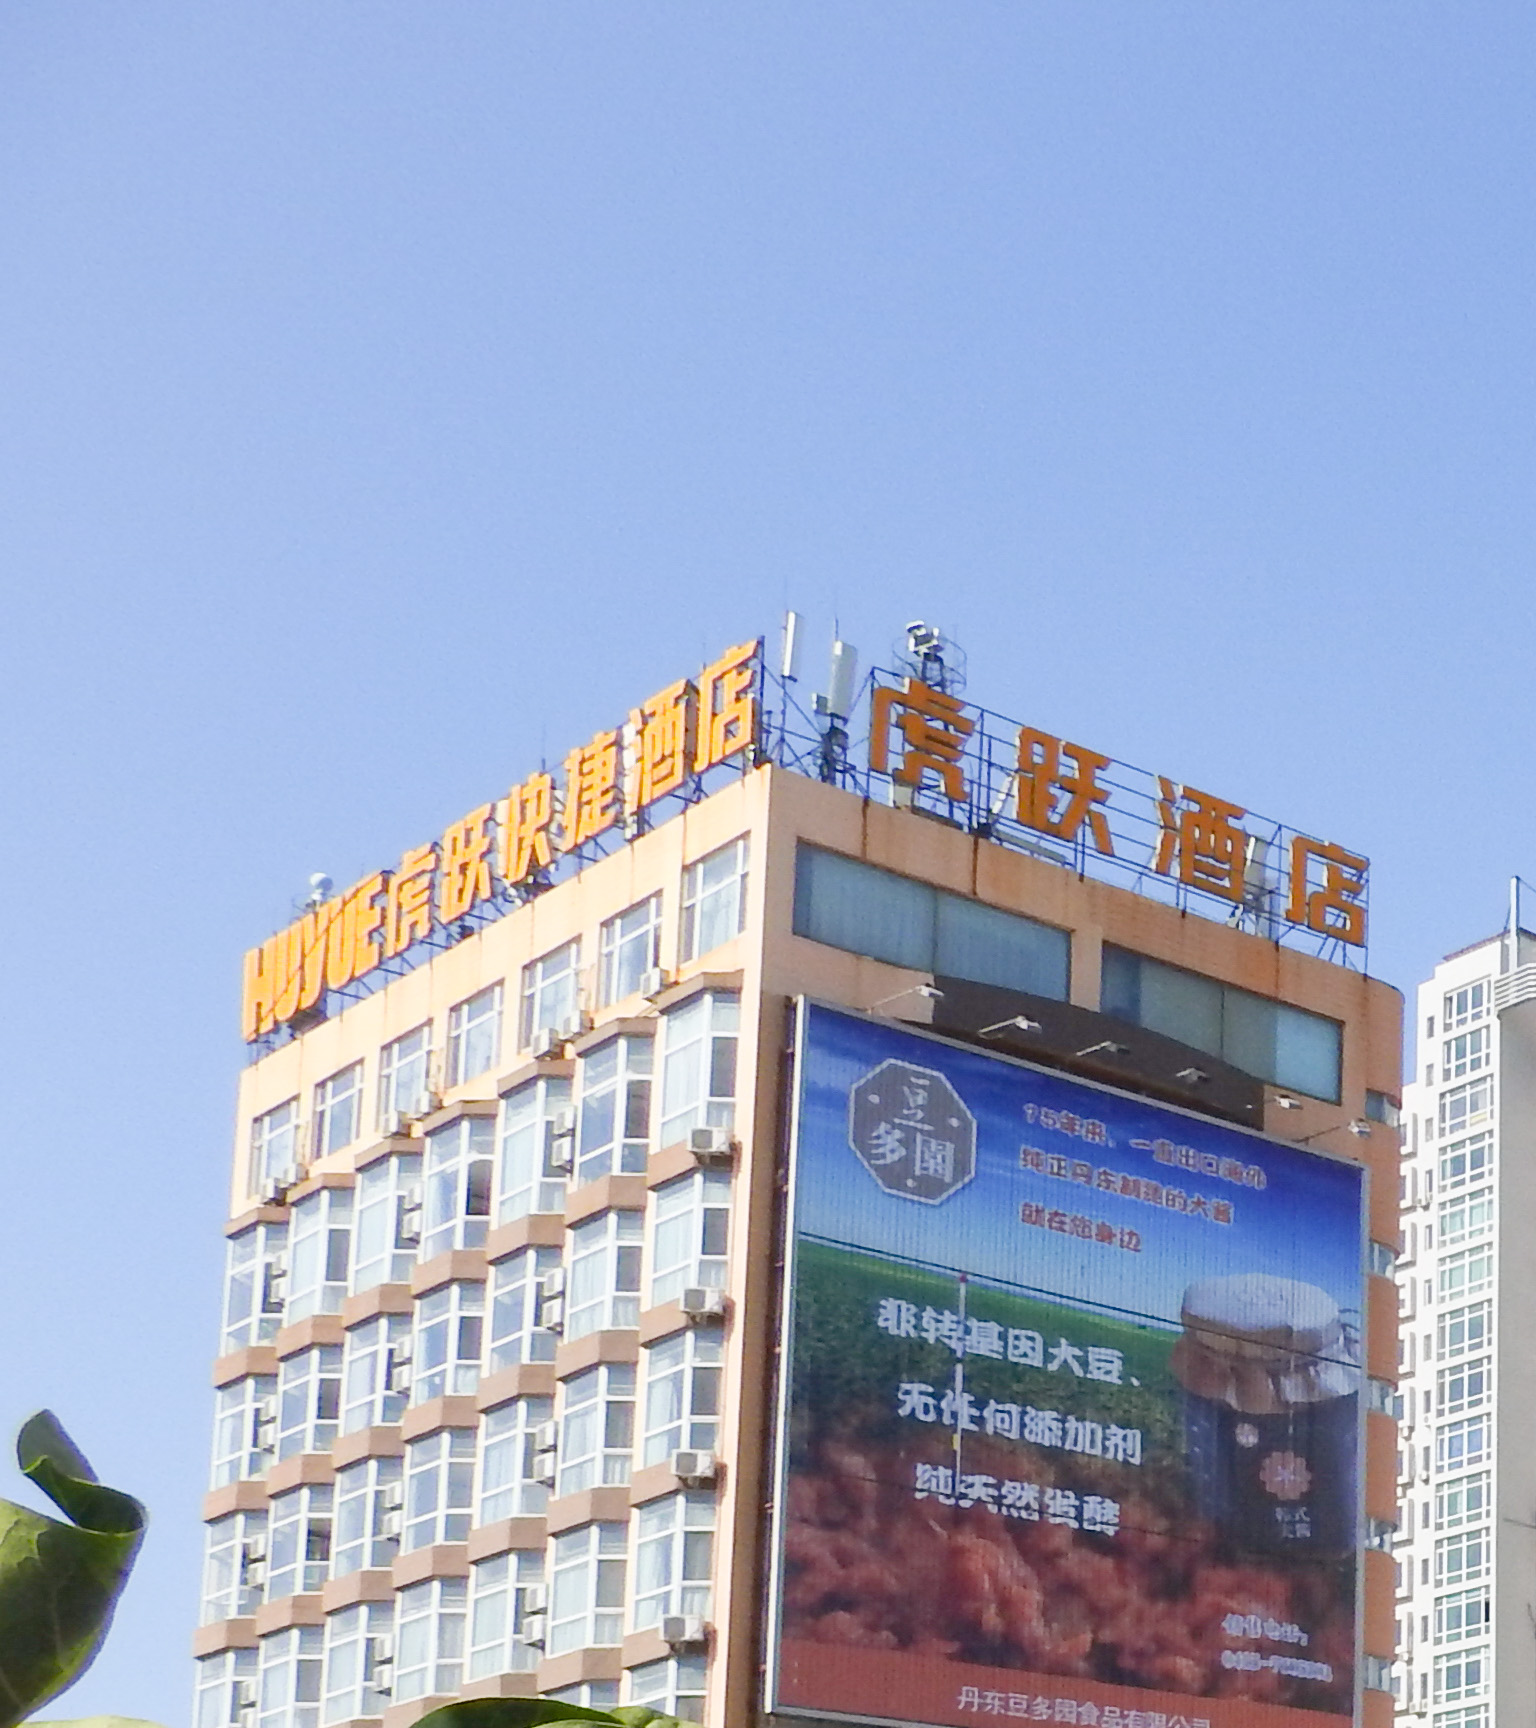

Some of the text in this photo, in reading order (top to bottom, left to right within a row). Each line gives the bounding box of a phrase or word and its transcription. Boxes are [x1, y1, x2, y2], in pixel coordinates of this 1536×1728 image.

[240, 636, 762, 1044] HUYUE 虎跃快捷酒店
[870, 677, 1370, 947] 虎跃酒店
